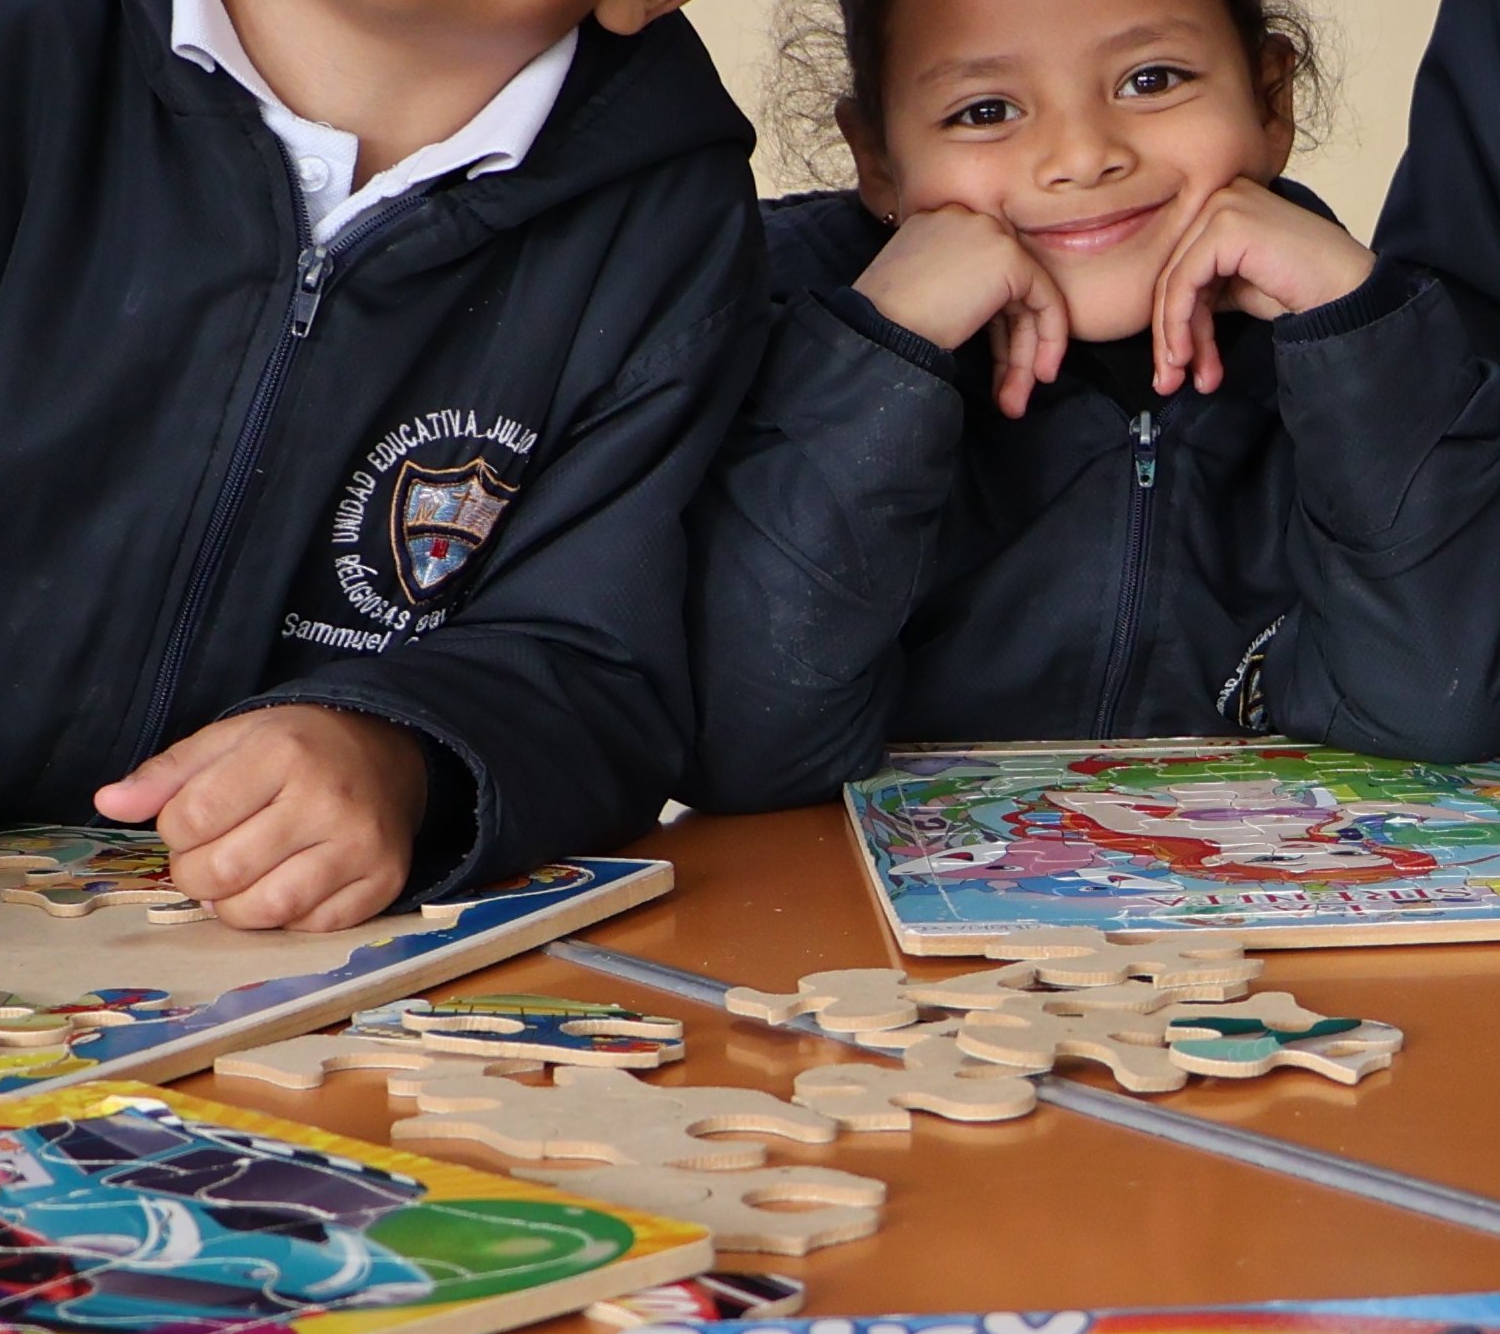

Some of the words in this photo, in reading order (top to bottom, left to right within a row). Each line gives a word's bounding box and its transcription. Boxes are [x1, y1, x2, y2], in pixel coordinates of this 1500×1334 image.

[332, 470, 377, 544] UNIDAD
[367, 409, 478, 473] EDUCATIVA
[334, 553, 412, 631] RELIGIOSAS
[281, 612, 394, 654] Sammuel
[1143, 886, 1471, 908] SIRENITA
